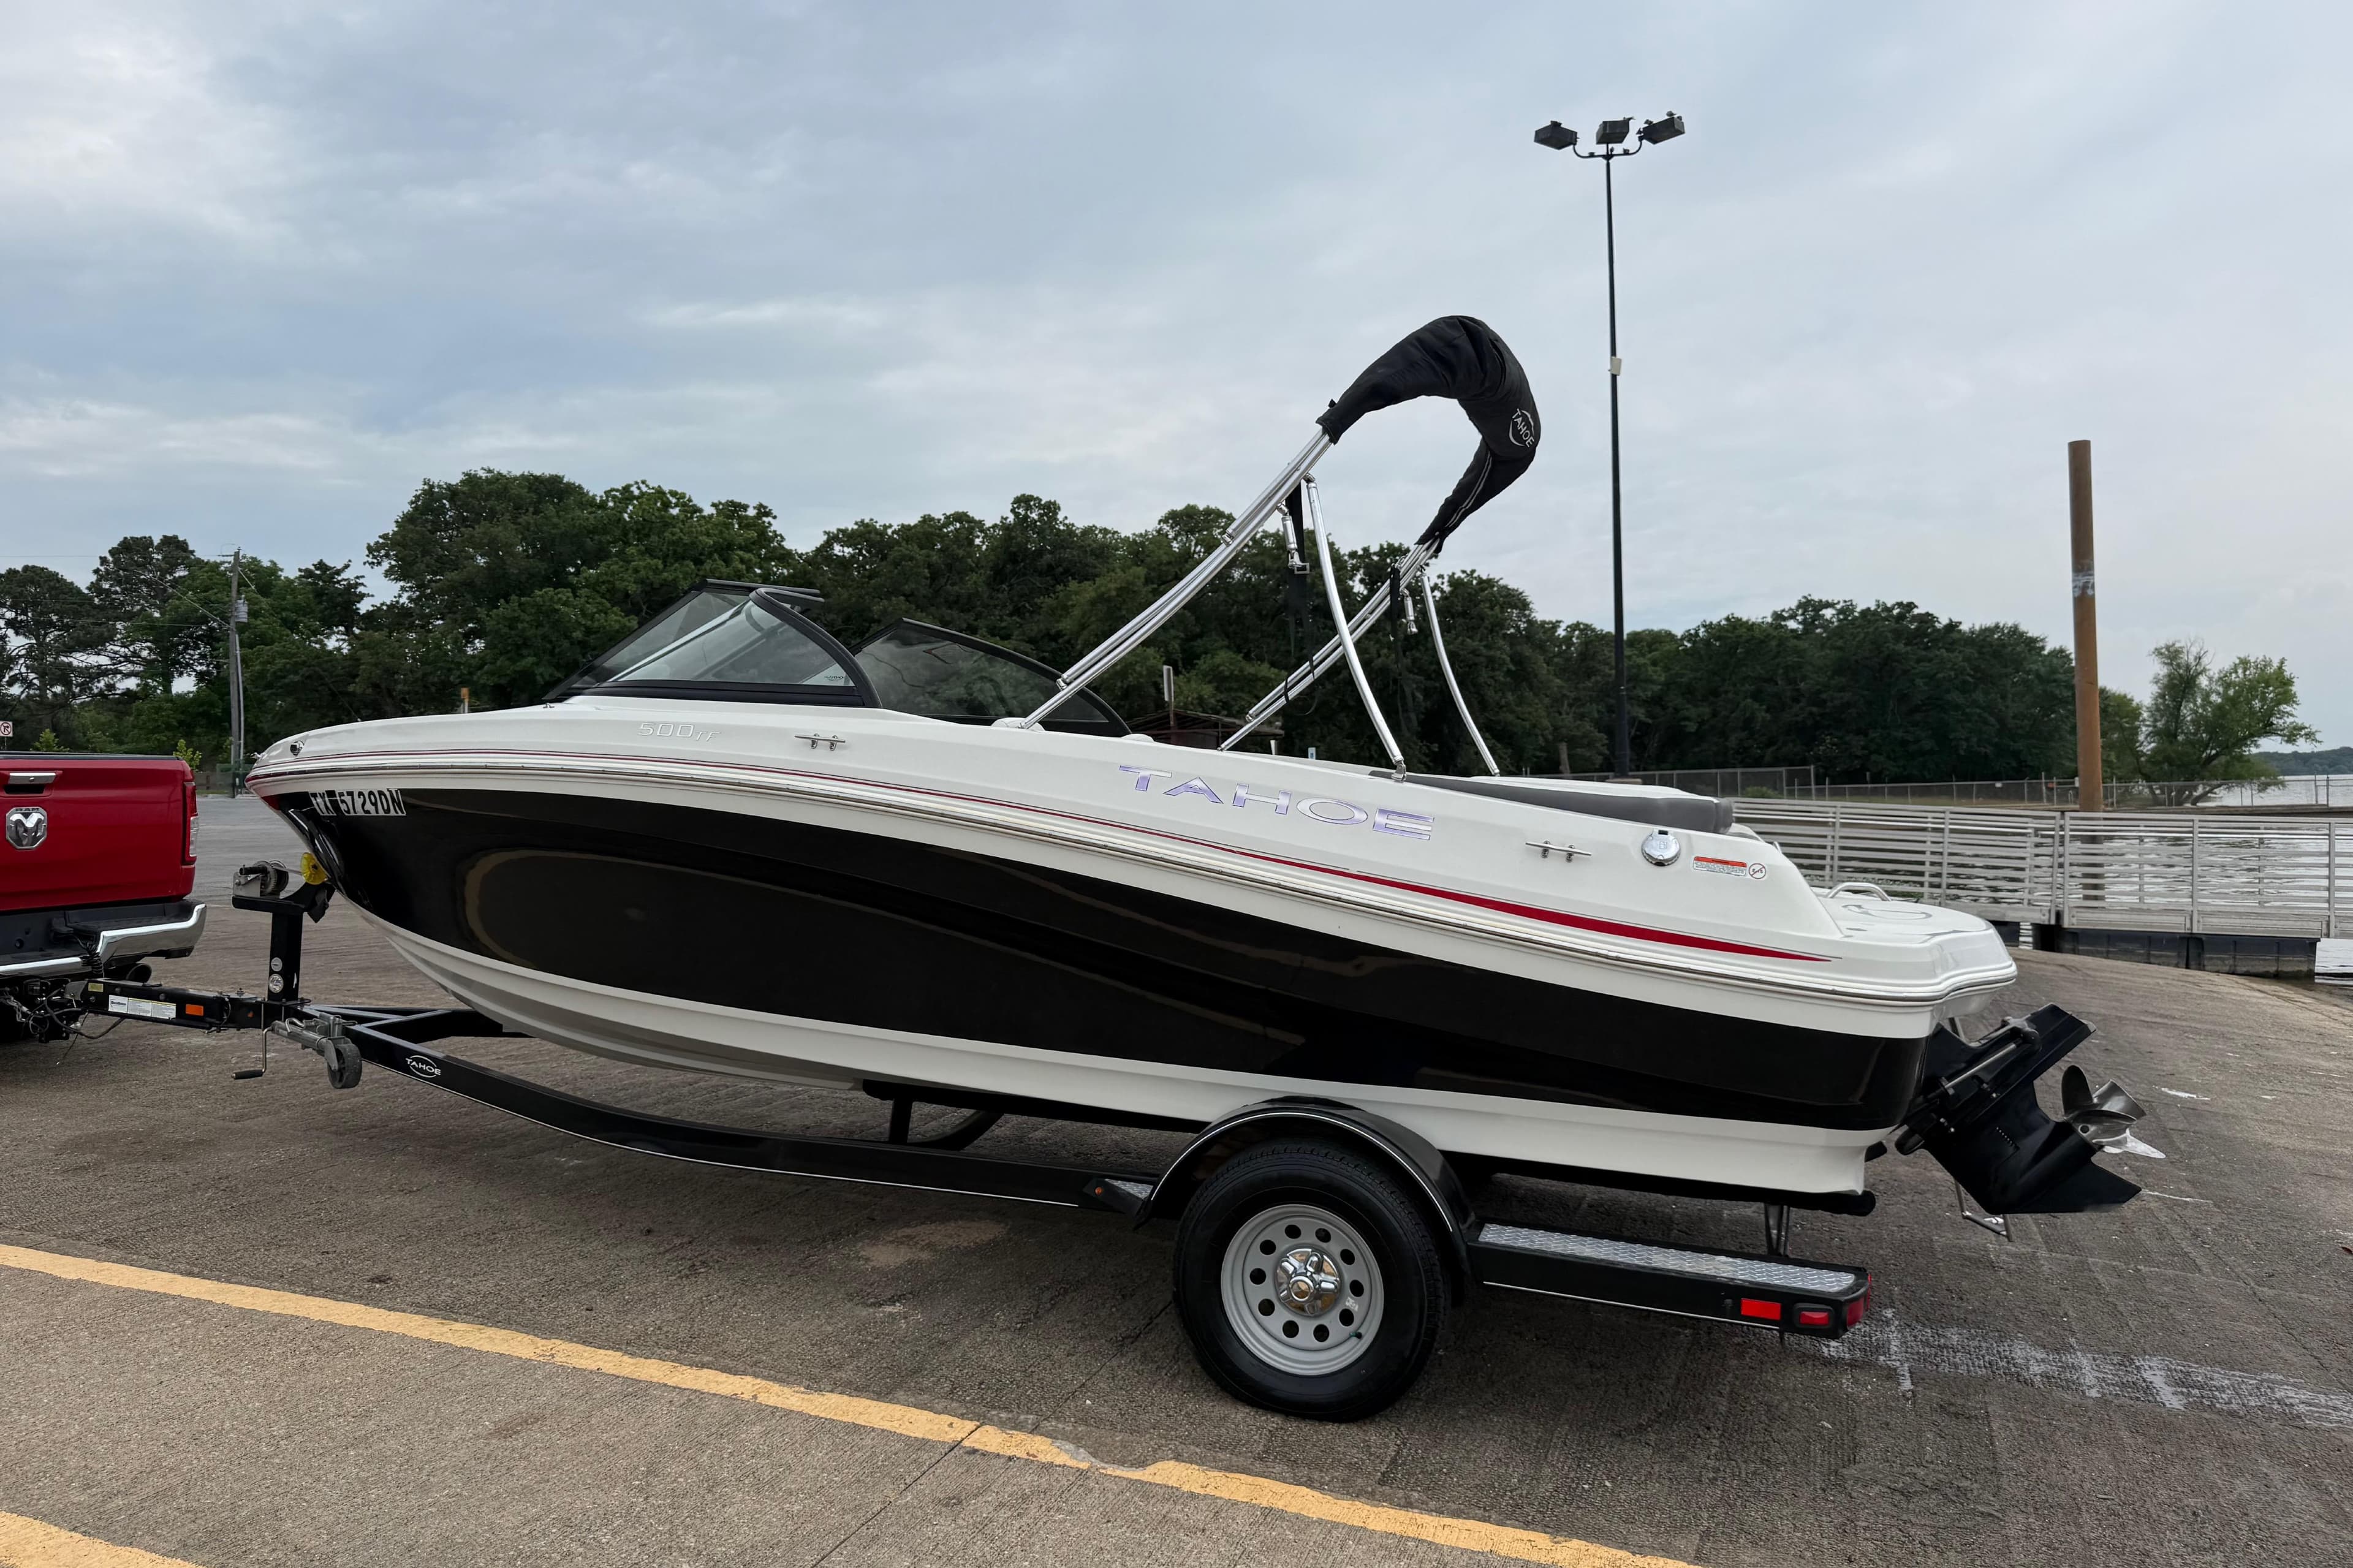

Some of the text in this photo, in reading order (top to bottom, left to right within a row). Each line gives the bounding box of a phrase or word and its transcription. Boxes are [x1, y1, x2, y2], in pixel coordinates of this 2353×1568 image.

[1512, 408, 1534, 448] TAHOE
[309, 789, 407, 815] TX 5729DN
[1118, 764, 1436, 841] TAHOE
[405, 1058, 441, 1076] TAHOE
